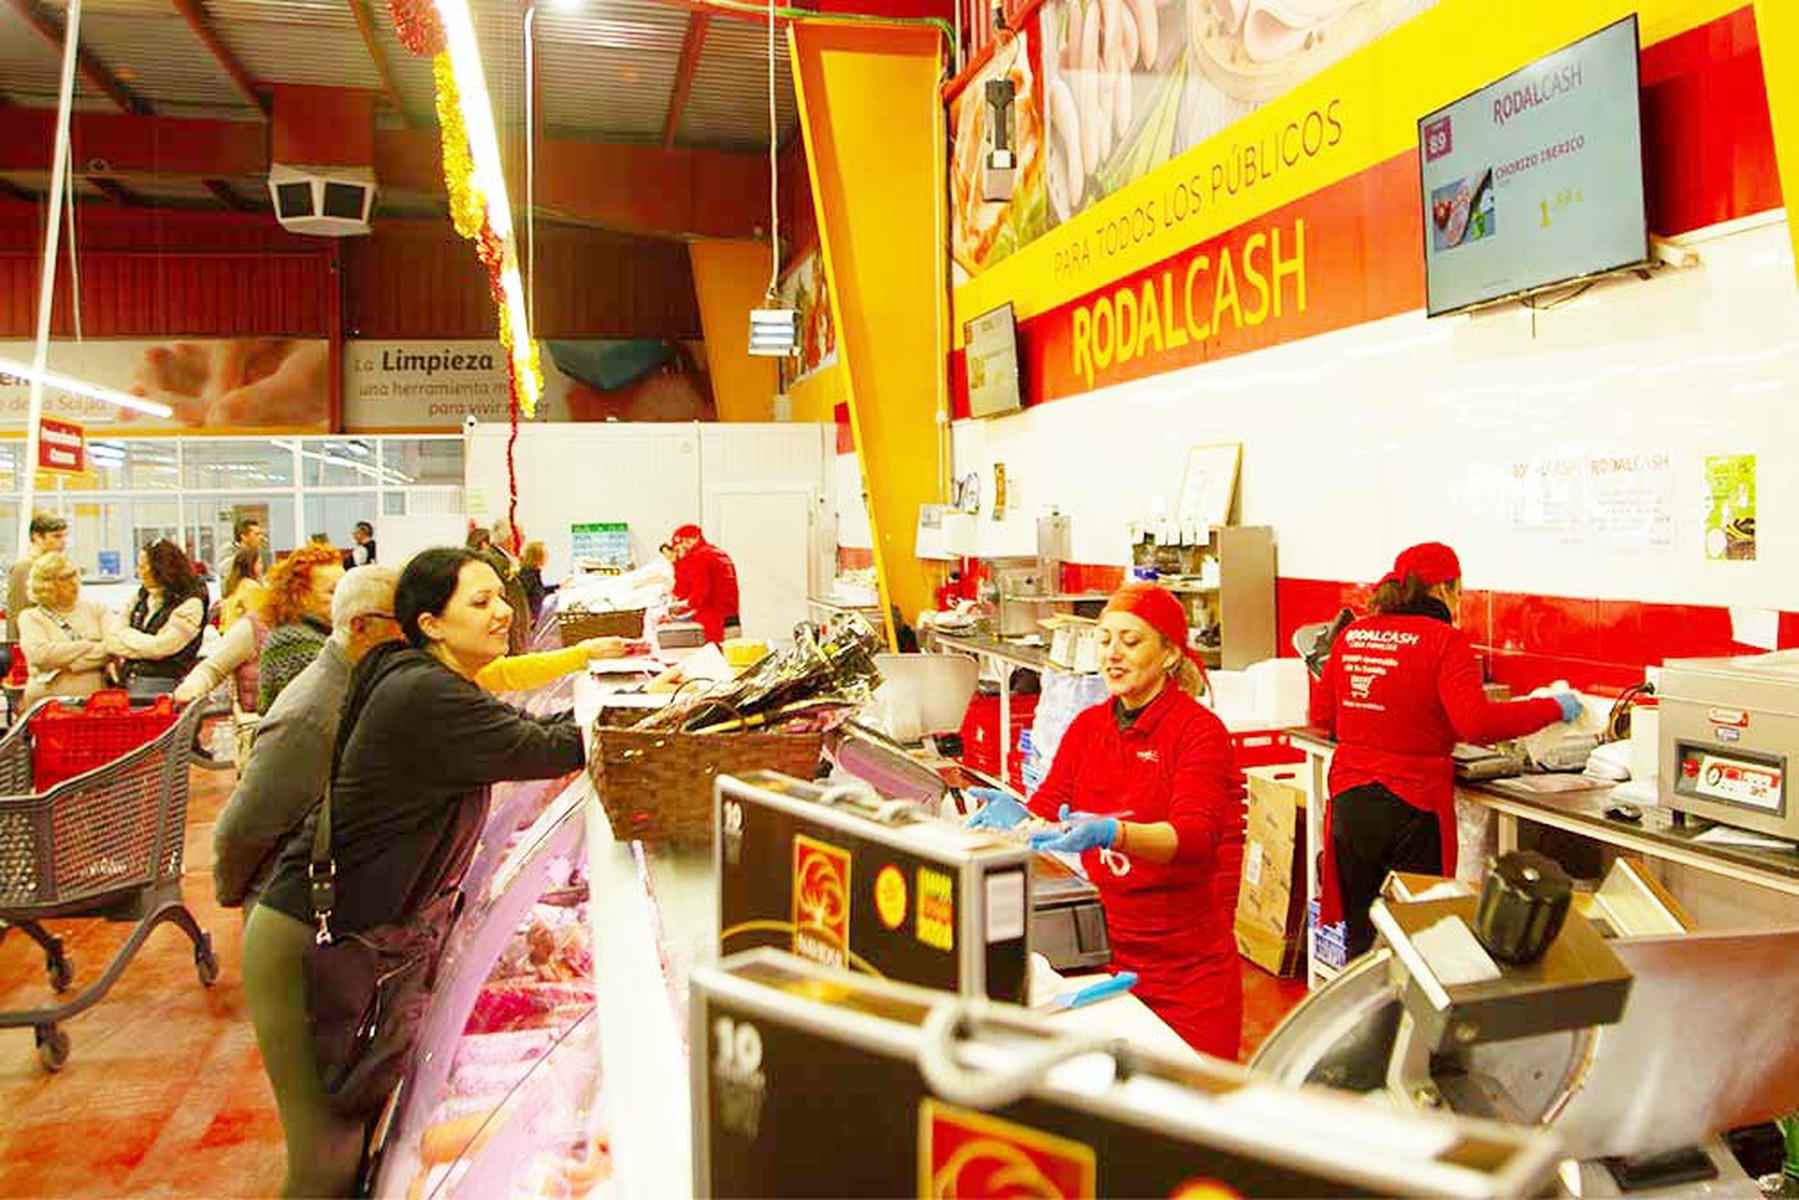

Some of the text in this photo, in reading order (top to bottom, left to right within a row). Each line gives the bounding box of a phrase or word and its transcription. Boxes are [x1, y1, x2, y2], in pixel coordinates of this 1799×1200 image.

[1493, 64, 1583, 125] RODALCASH
[1495, 156, 1539, 180] CHORIZO
[1053, 98, 1343, 279] PARA TODOS LOS PÚBLICOS
[1072, 218, 1307, 389] RODALCASH
[382, 349, 494, 376] Limpieza
[359, 384, 389, 397] una
[392, 379, 489, 396] herramienta
[429, 402, 468, 418] para
[714, 1019, 763, 1072] 10
